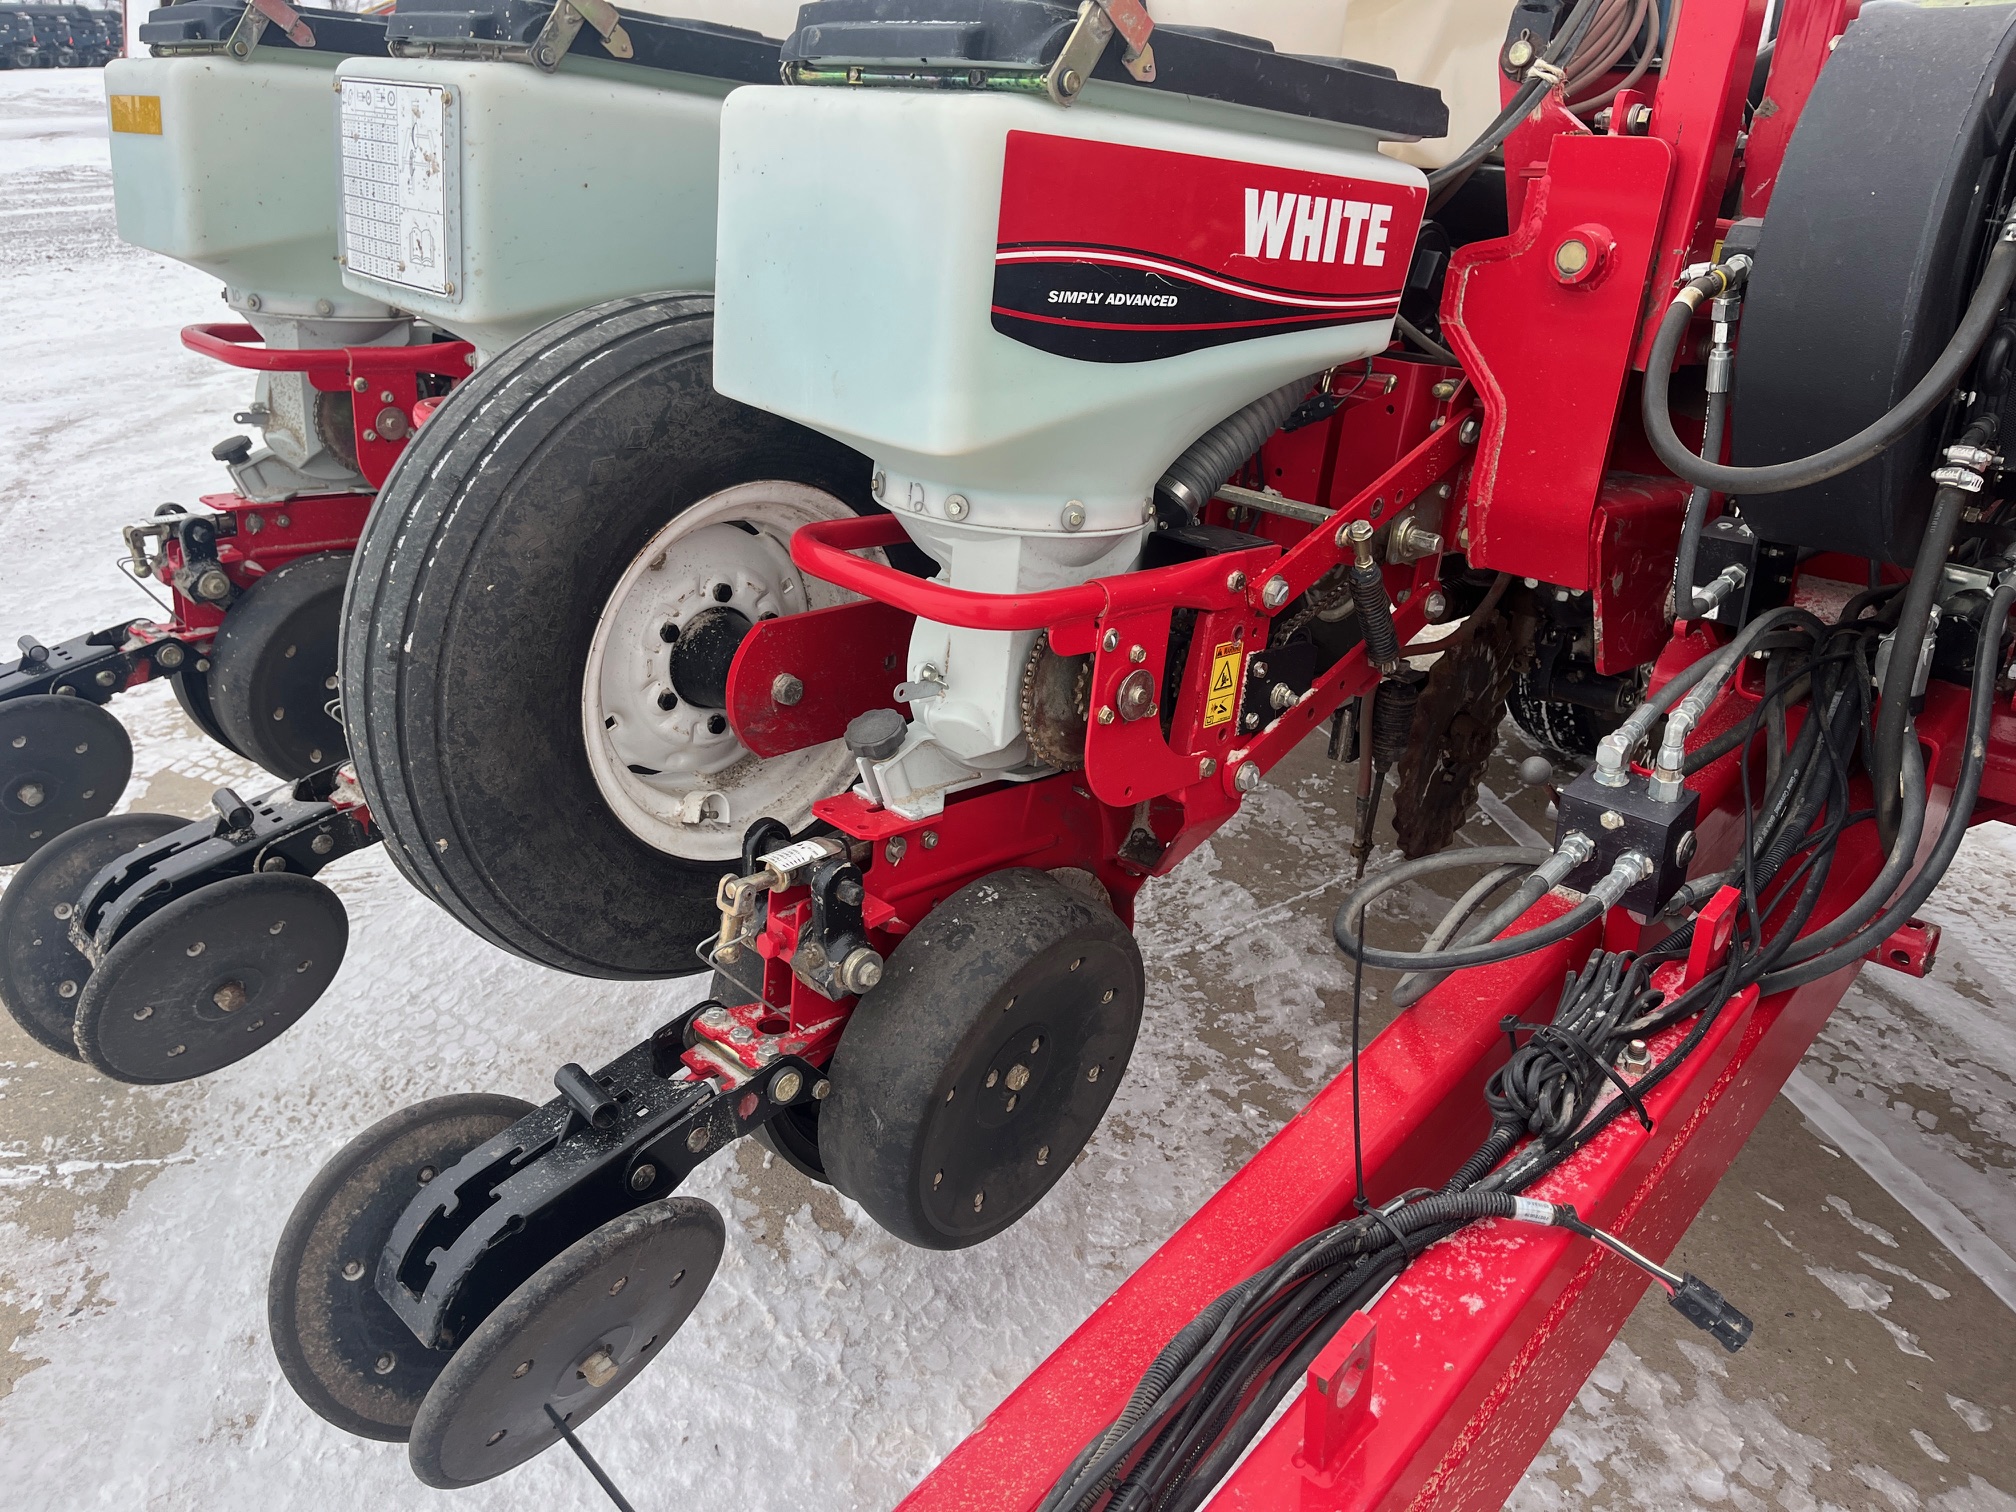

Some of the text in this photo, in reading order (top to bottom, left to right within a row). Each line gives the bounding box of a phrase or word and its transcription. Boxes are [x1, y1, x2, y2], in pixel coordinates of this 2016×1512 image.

[1245, 188, 1393, 267] WHITE
[1048, 290, 1178, 307] SIMPLY ADVANCED
[908, 481, 930, 514] 12
